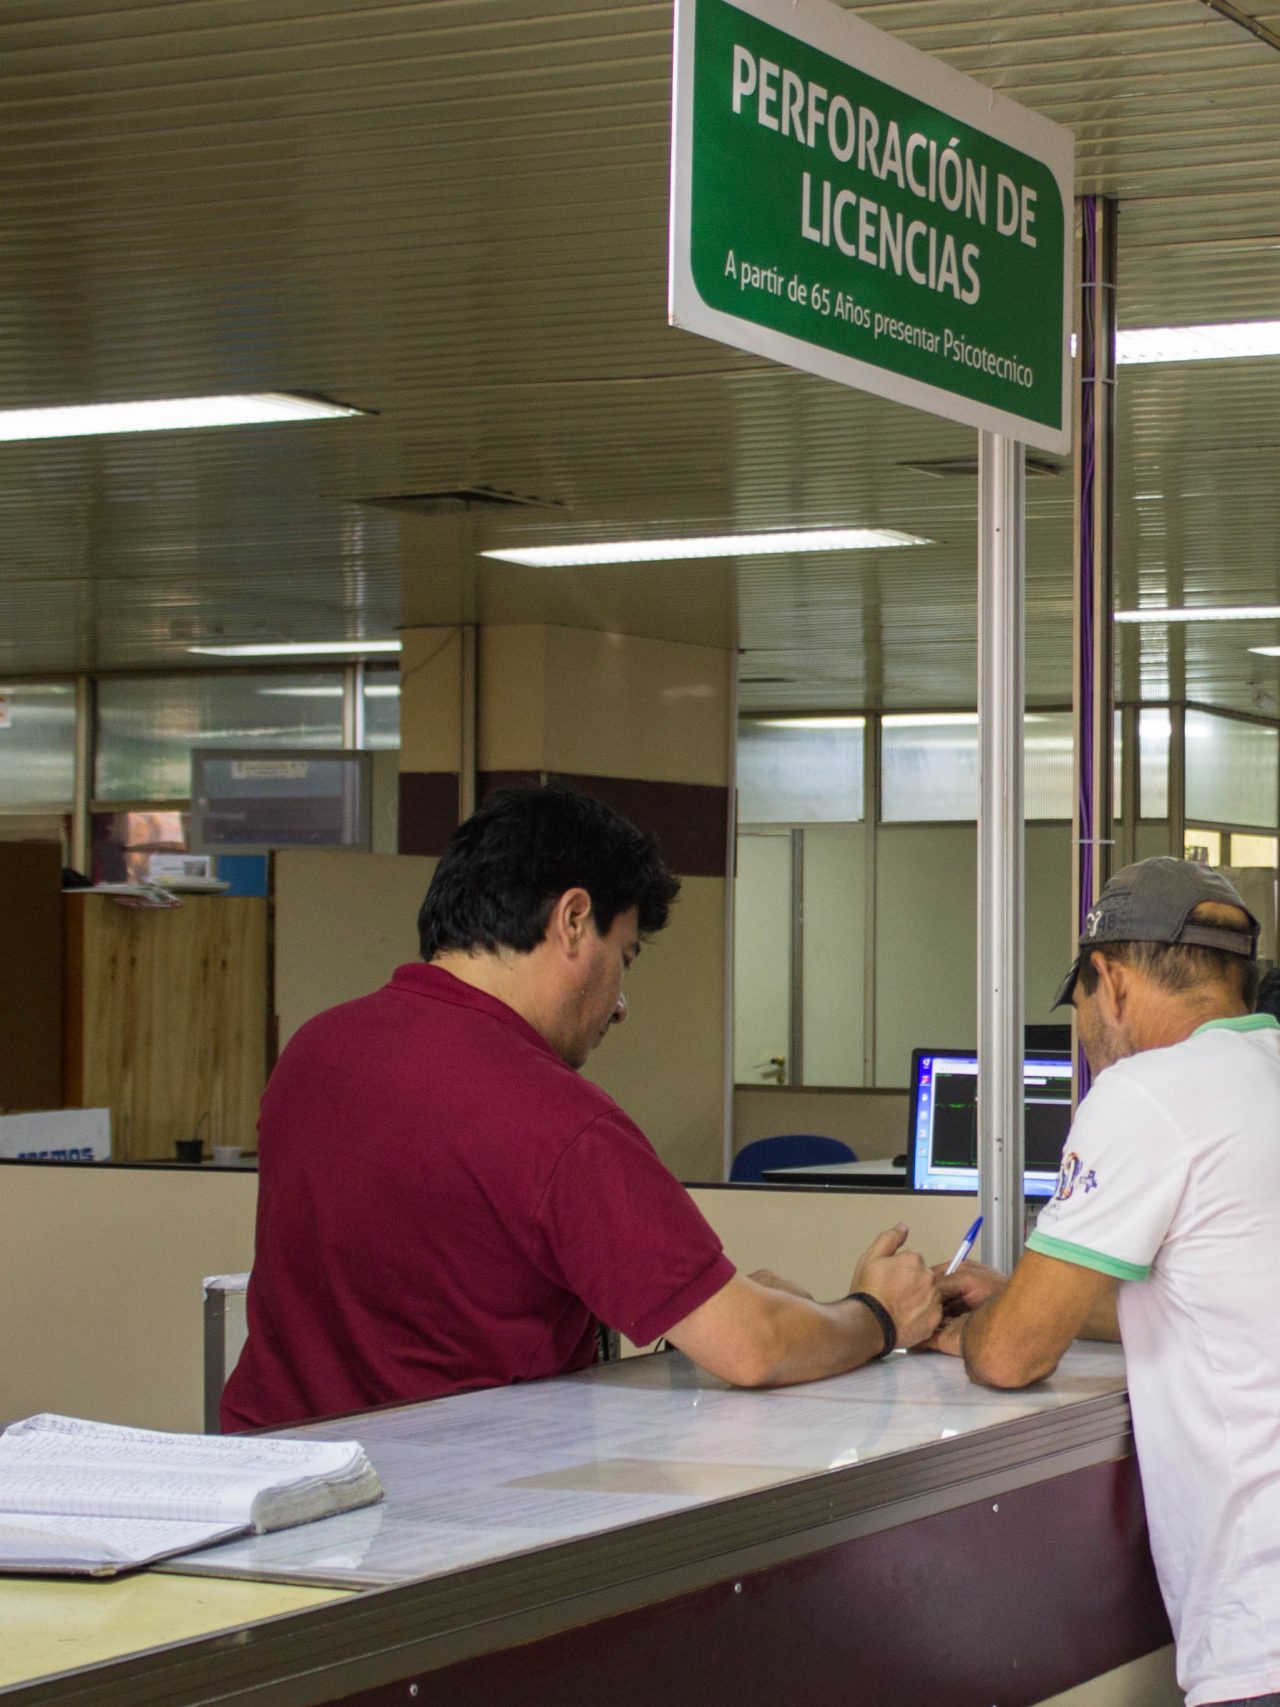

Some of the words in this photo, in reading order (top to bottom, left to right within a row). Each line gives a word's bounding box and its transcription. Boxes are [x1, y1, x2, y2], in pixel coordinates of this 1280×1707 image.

[732, 45, 987, 225] PERFORACIÓN
[996, 173, 1037, 248] DE
[802, 171, 981, 305] LICENCIAS
[724, 250, 737, 280] A
[740, 261, 784, 296] partir
[787, 274, 807, 305] de
[811, 283, 830, 315] 65
[834, 291, 871, 328] Años
[874, 312, 940, 353] presentar
[943, 328, 1033, 388] Psicotecnico
